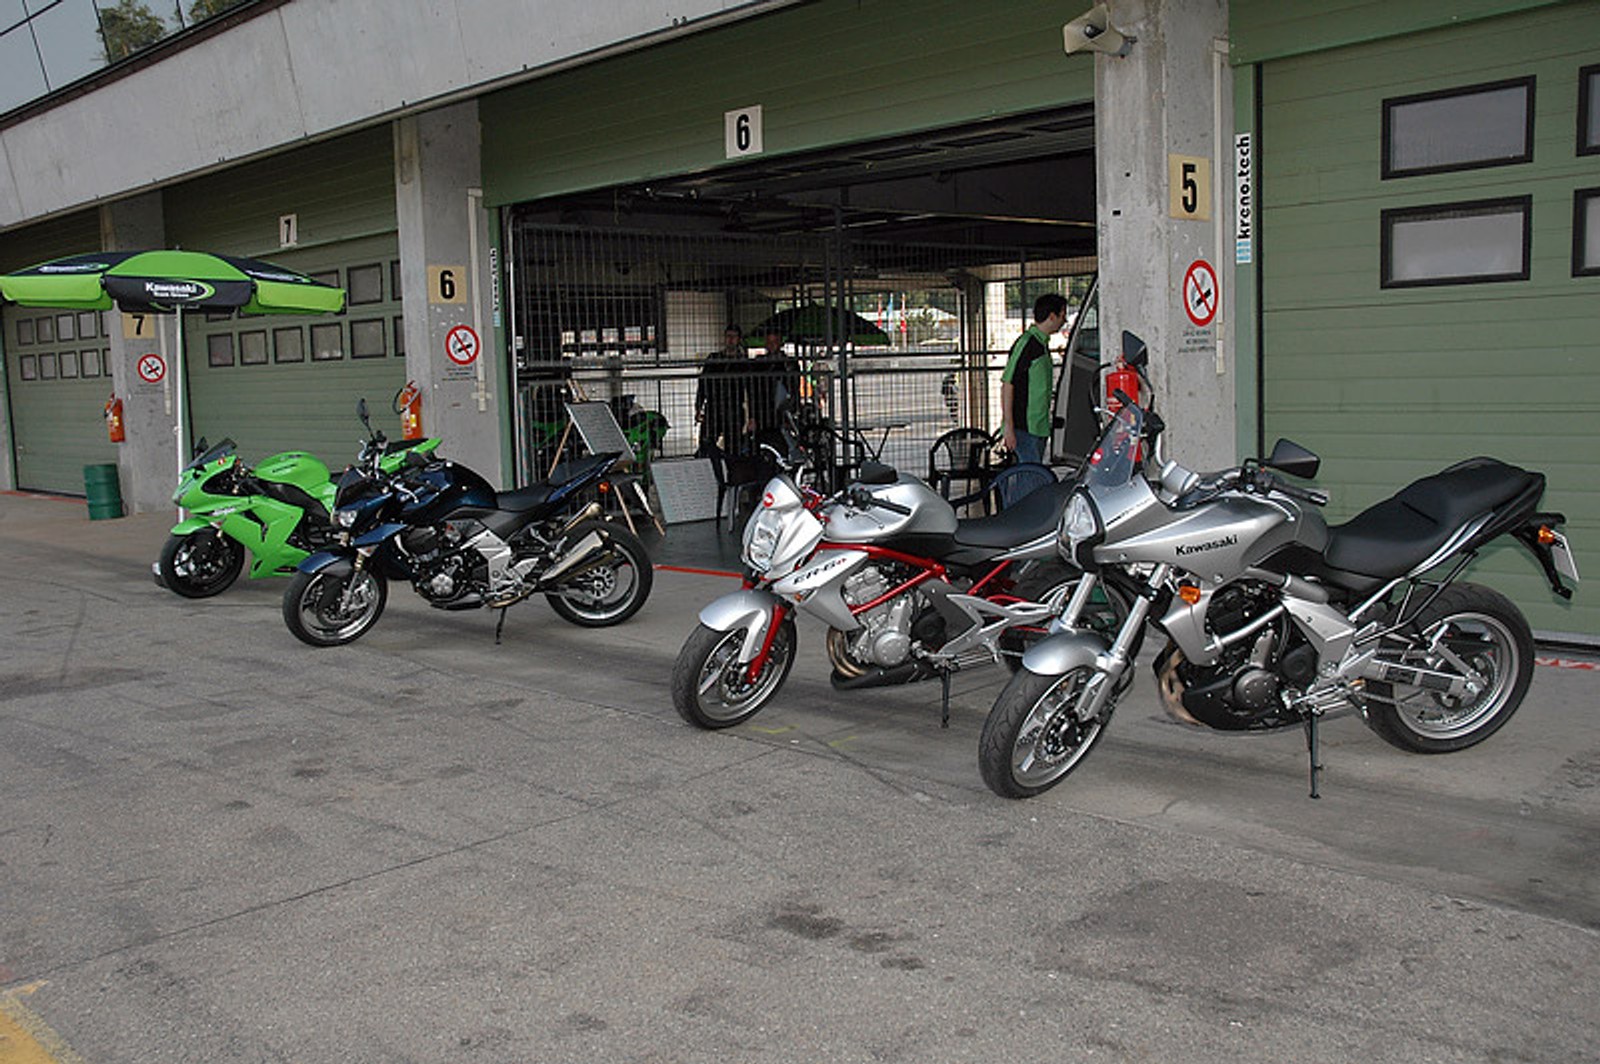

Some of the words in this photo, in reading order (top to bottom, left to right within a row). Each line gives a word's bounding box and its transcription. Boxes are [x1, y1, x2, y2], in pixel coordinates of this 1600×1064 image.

[736, 113, 750, 151] 6
[1182, 162, 1197, 213] 5
[1236, 135, 1251, 239] kreno.tech
[440, 269, 455, 300] 6
[132, 313, 145, 335] 7
[1175, 534, 1238, 556] Kawasaki
